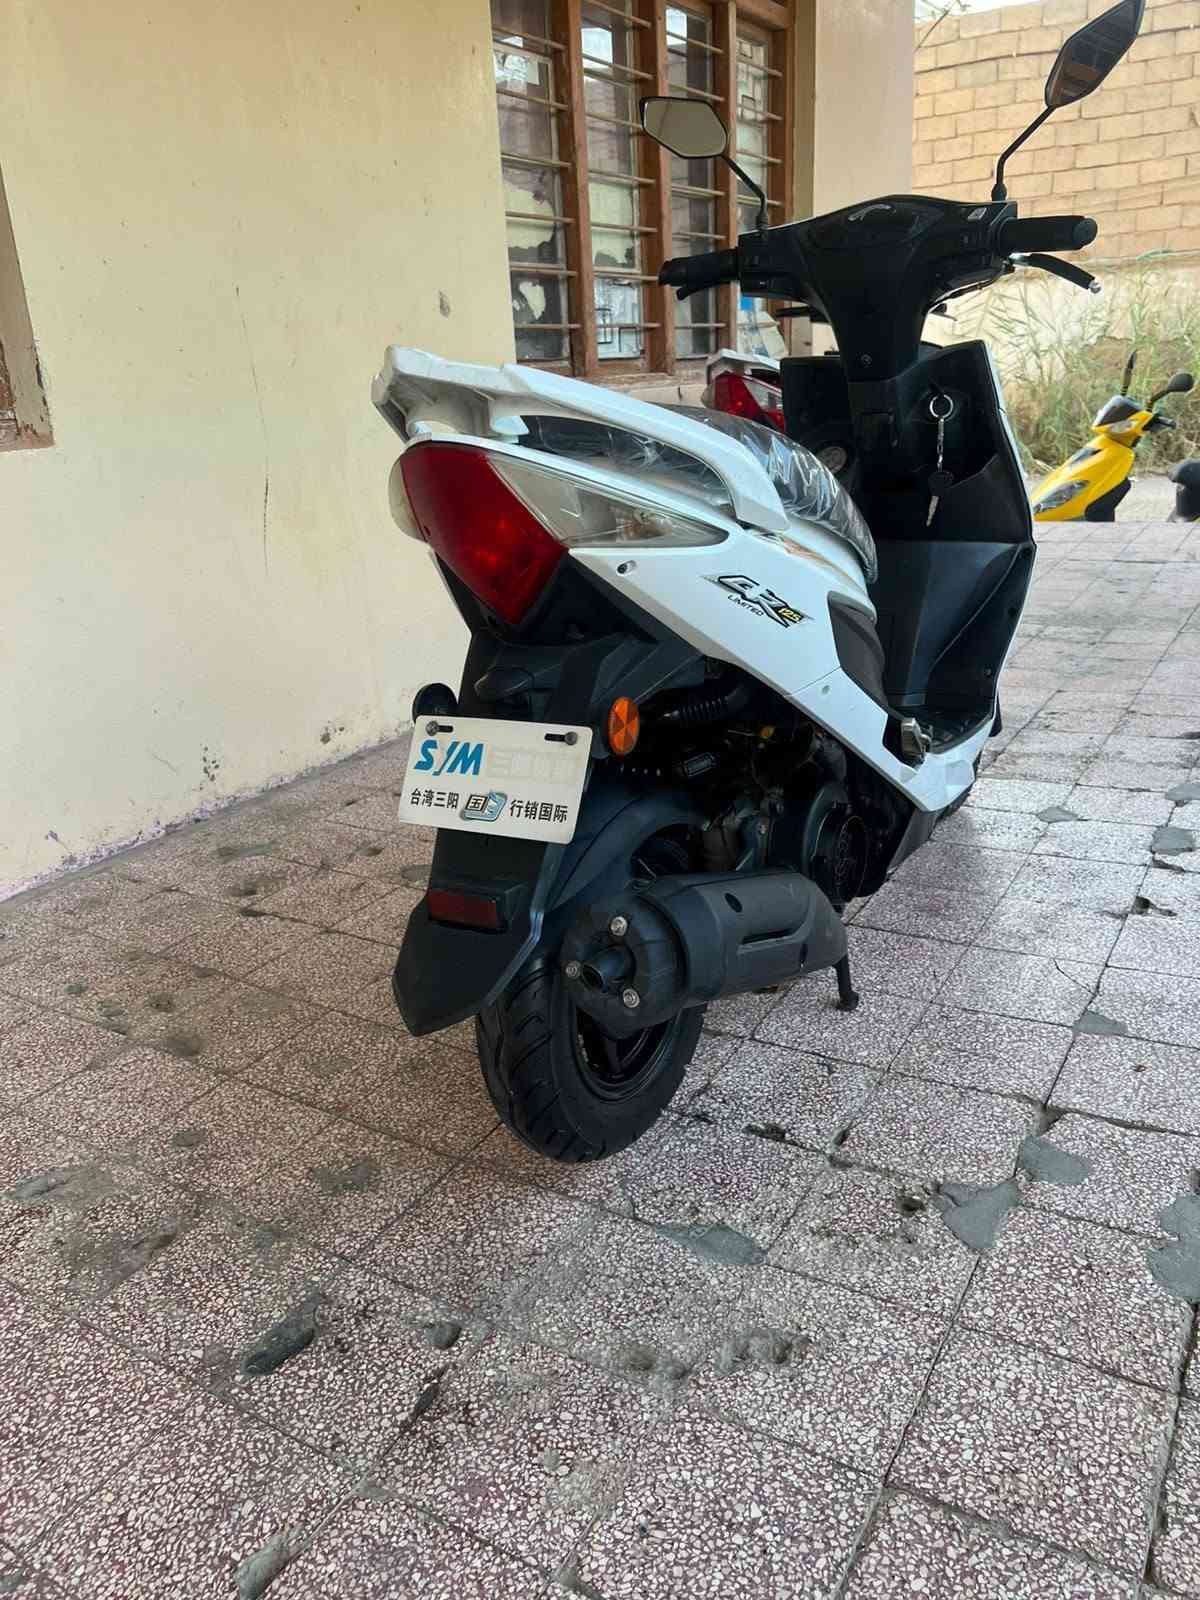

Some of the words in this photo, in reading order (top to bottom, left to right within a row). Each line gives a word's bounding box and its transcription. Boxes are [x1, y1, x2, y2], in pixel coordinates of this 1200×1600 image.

[727, 594, 764, 617] LIMITED
[778, 606, 802, 622] 125
[414, 739, 484, 776] SYM
[410, 788, 460, 809] 台湾三阳
[509, 799, 568, 823] 行销国际
